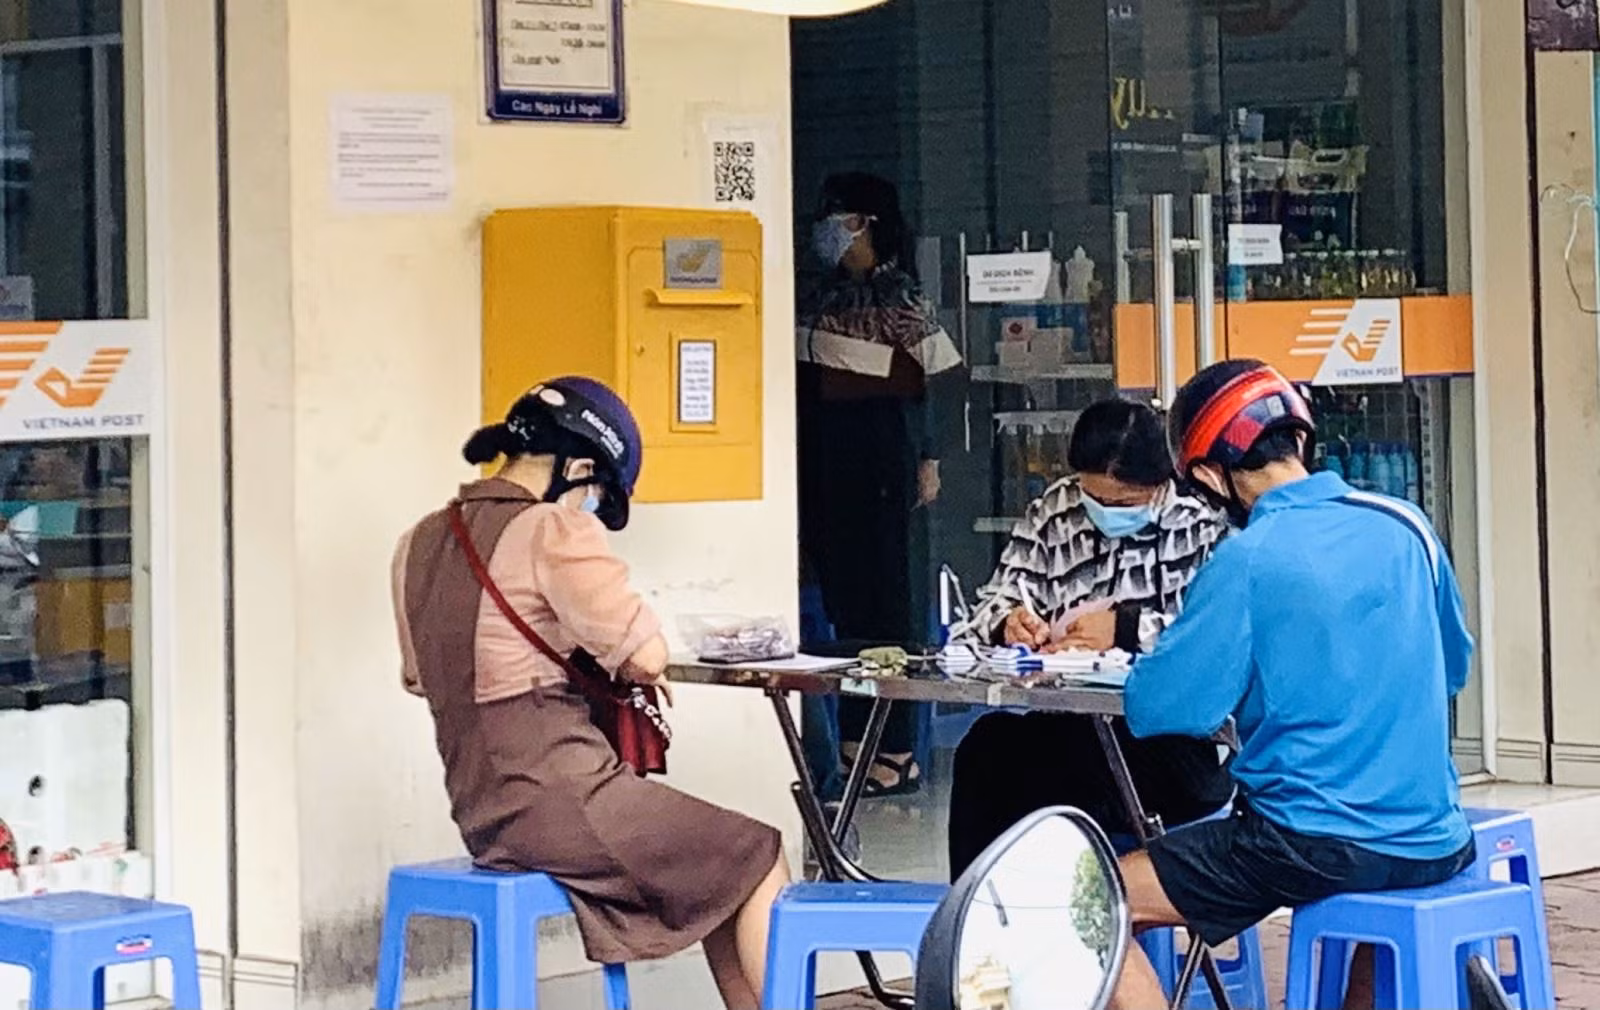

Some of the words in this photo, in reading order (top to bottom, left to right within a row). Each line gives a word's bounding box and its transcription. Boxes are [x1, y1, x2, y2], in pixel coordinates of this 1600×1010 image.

[1336, 367, 1374, 378] VIETNAM
[1376, 366, 1399, 377] POST
[23, 416, 96, 430] VIETNAM
[102, 414, 145, 427] POST
